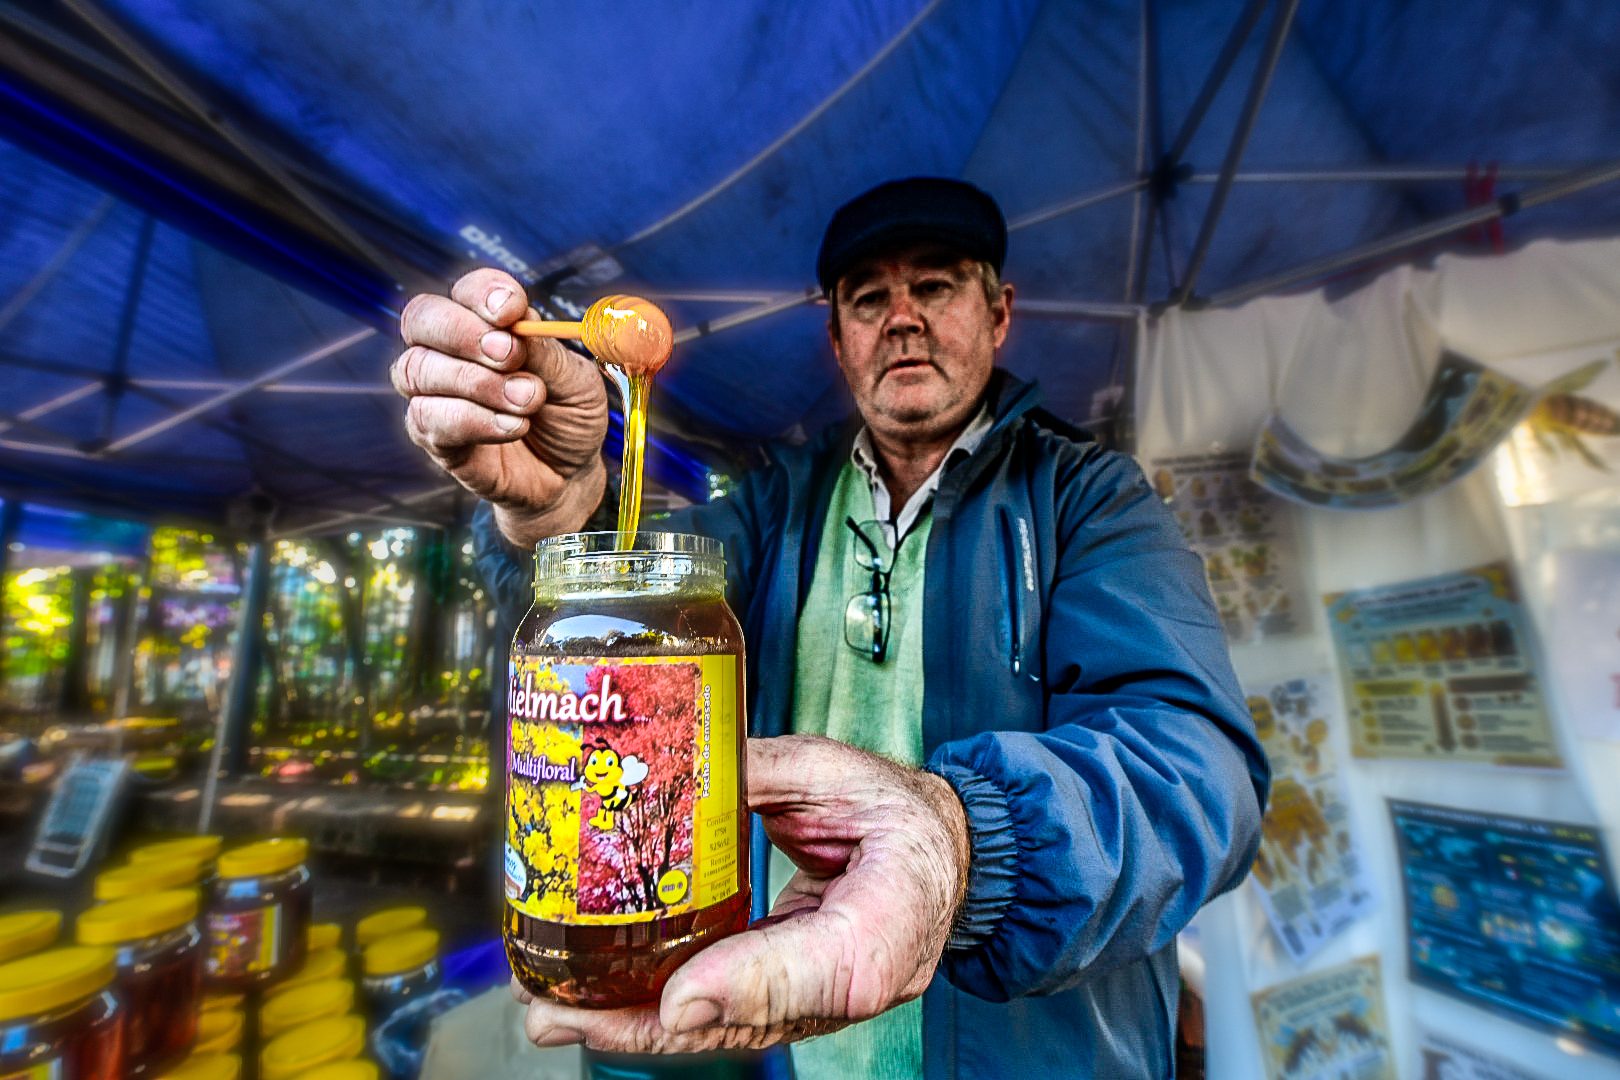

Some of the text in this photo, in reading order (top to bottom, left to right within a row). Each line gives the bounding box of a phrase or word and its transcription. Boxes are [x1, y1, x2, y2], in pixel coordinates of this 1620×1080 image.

[512, 751, 576, 785] Multifloral
[702, 684, 711, 798] Fecha de envasado
